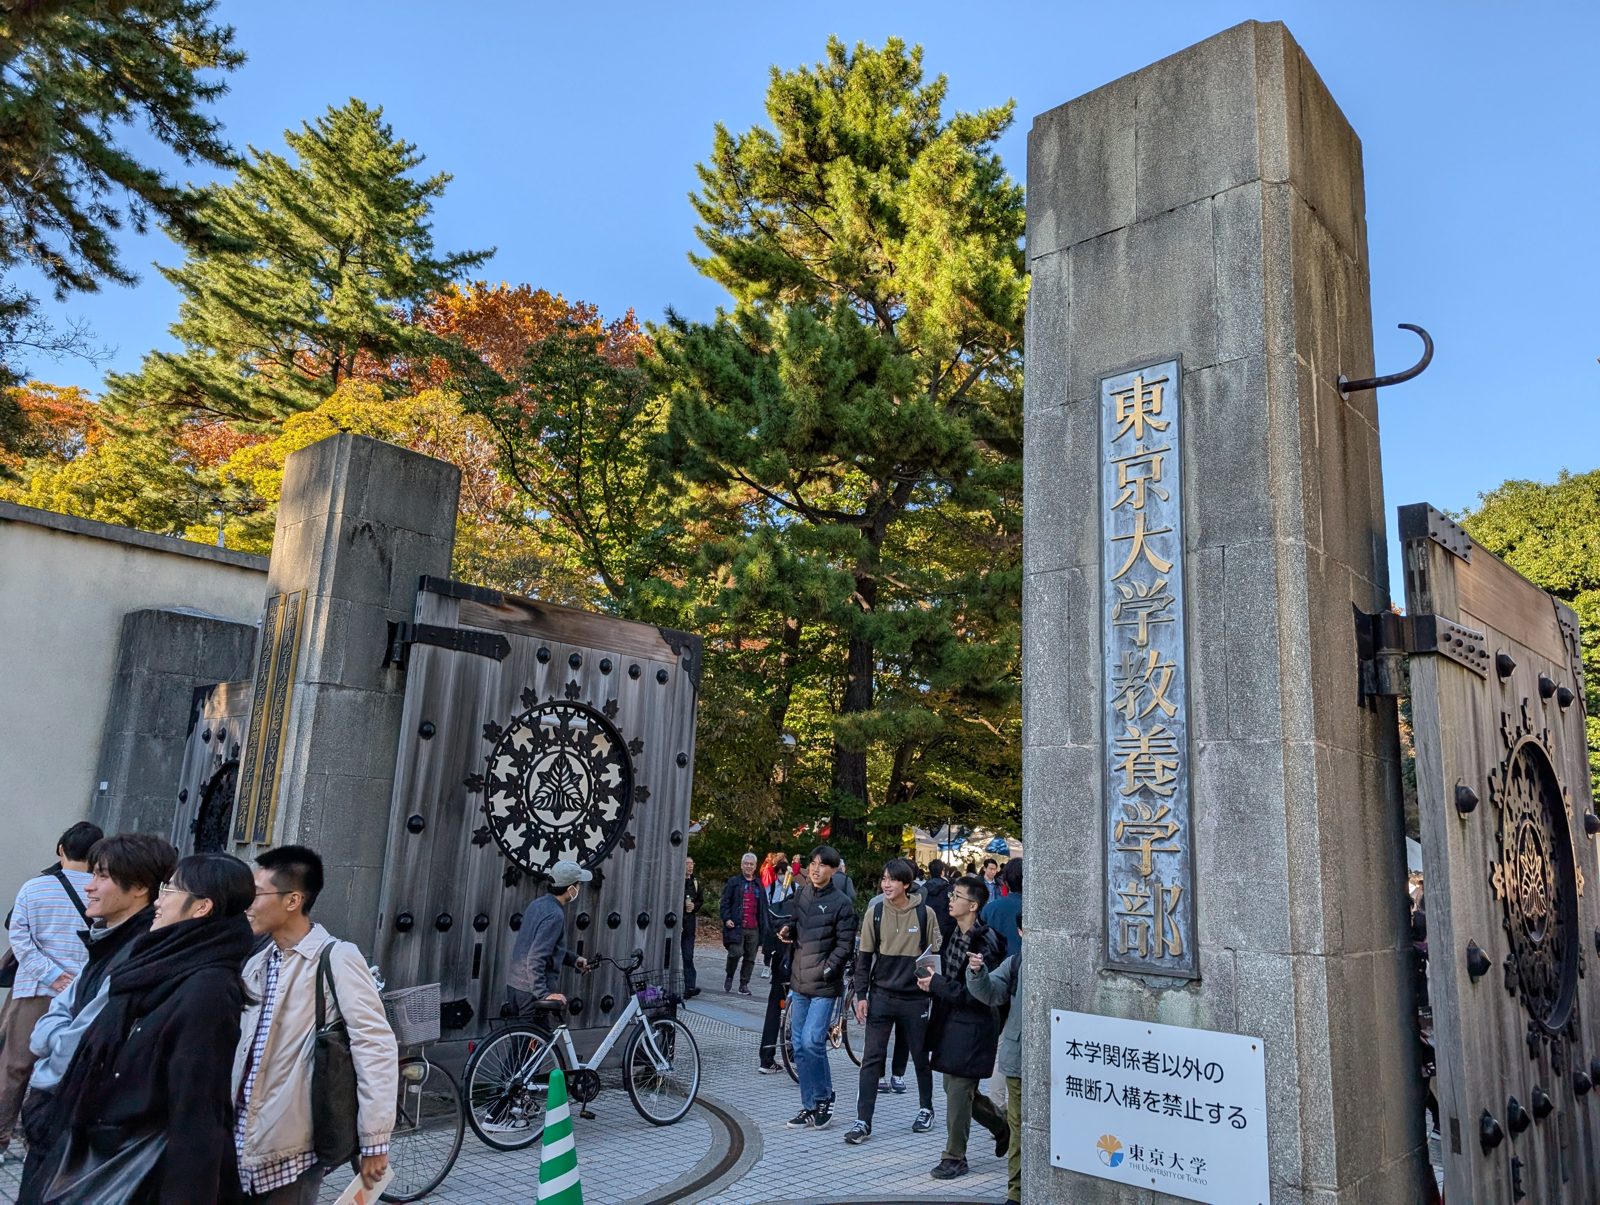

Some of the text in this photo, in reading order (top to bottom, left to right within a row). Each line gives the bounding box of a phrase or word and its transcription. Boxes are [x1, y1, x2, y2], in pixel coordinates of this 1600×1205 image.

[1110, 375, 1184, 959] 東京大学教養学部
[1065, 1038, 1225, 1084] 本学関係者以外の
[1065, 1074, 1248, 1130] 無断入構を禁止する
[1129, 1143, 1207, 1175] 東京大学
[1129, 1161, 1208, 1186] THE UNIVERSITY OF TOKYO
